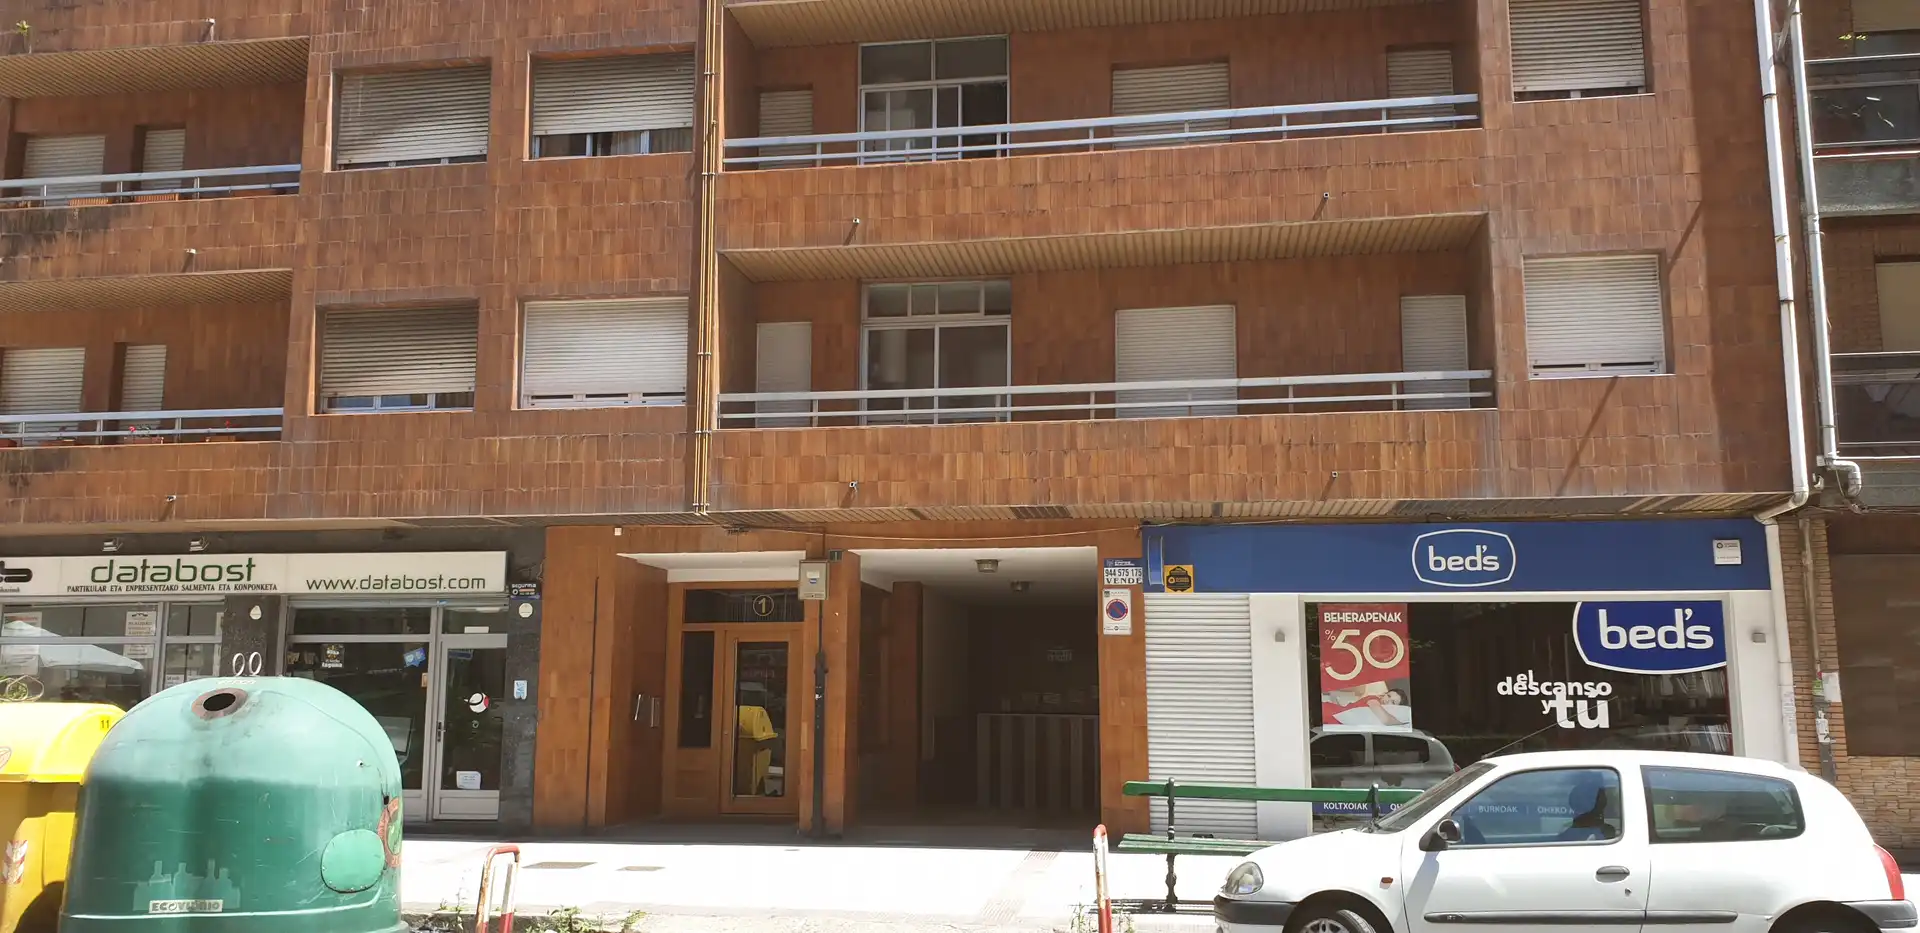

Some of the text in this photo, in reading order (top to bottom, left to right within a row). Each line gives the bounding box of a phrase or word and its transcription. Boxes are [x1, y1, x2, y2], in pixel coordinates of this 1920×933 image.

[1428, 545, 1500, 571] bed's
[91, 557, 256, 583] databost
[1104, 568, 1143, 577] 944 575 175
[66, 583, 278, 593] PARTIKULAR ETA ENPRESENTZAKO SALMENTA ETA KONPONKETA
[306, 574, 486, 591] www.databost.com
[1105, 577, 1143, 585] VENDE
[758, 597, 766, 614] 1
[1323, 611, 1403, 623] BEHERAPENAK
[1598, 608, 1714, 650] bed's
[1516, 669, 1534, 687] el
[1496, 676, 1613, 697] descanso
[100, 719, 110, 729] 11
[1323, 802, 1369, 811] KOLTXOIAK
[1478, 805, 1519, 814] BURKOAK
